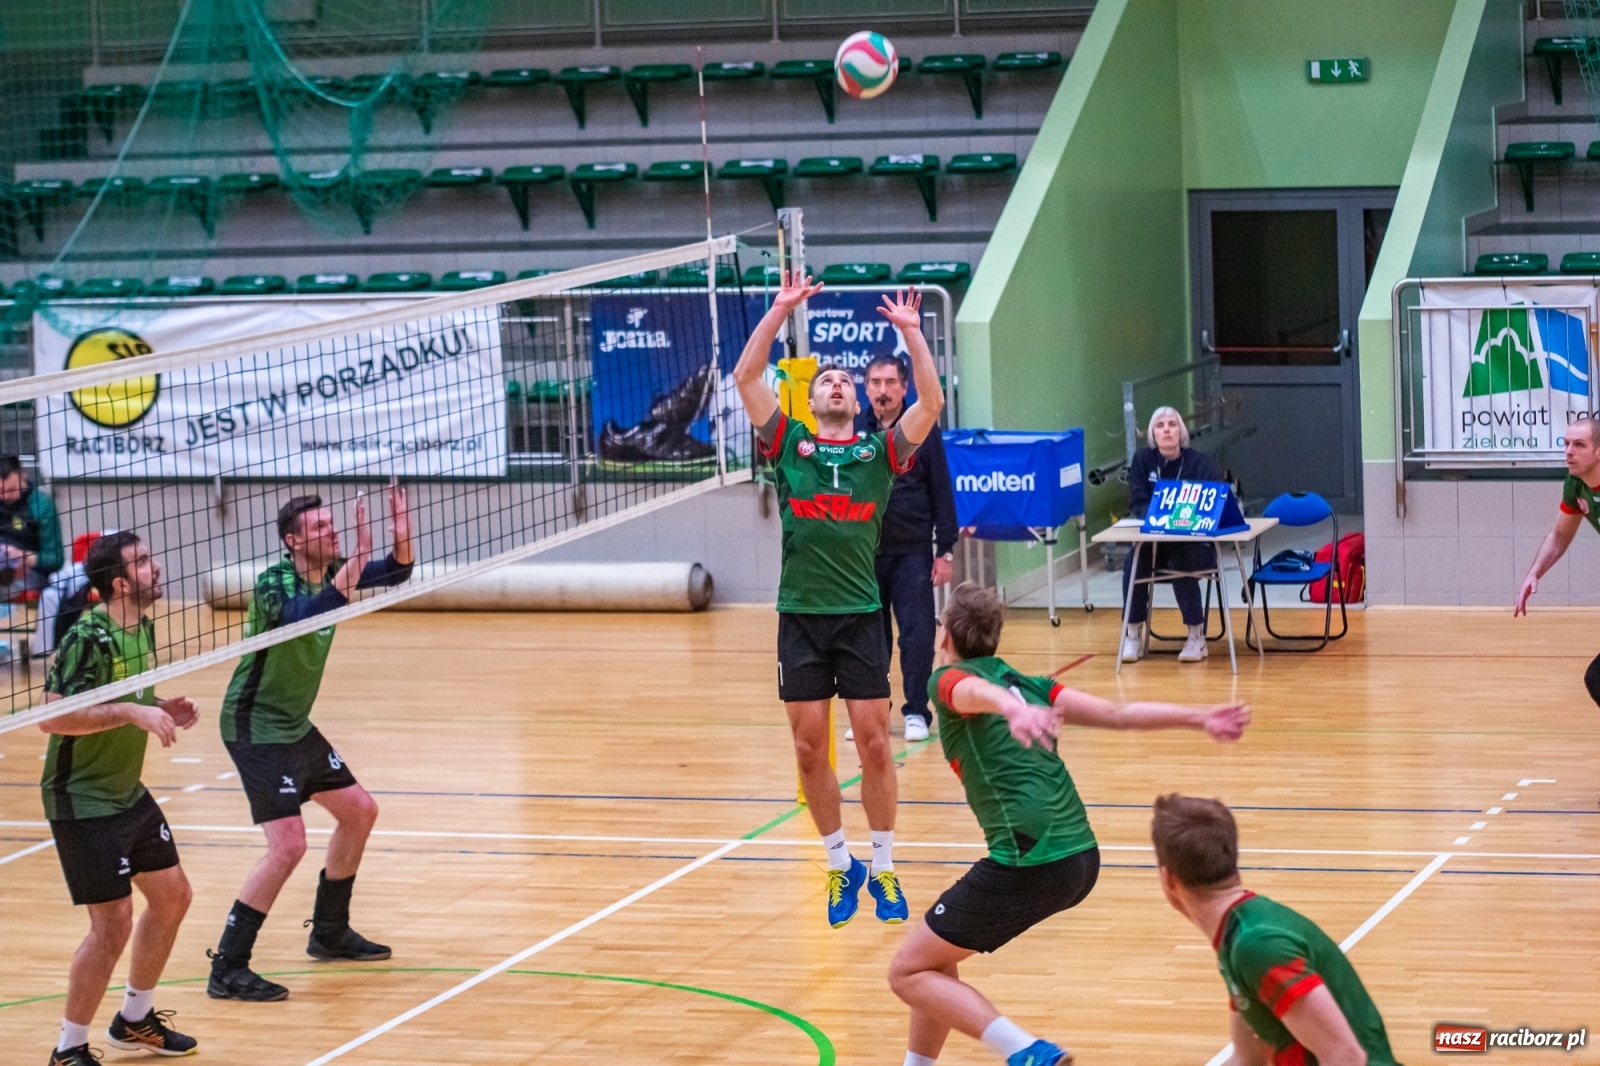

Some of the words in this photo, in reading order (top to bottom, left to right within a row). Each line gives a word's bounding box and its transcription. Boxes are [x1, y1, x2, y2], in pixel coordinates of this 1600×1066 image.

[805, 308, 854, 320] portowy
[813, 322, 889, 343] SPORT
[809, 349, 875, 368] Racibó
[186, 403, 252, 446] JEST
[260, 391, 287, 419] W
[297, 328, 474, 406] PORZĄDKU!
[1462, 404, 1549, 433] powiat
[1462, 433, 1538, 449] zielona
[956, 471, 1035, 492] molten
[1160, 486, 1177, 510] 14
[1199, 487, 1217, 512] 13
[160, 822, 170, 842] 6
